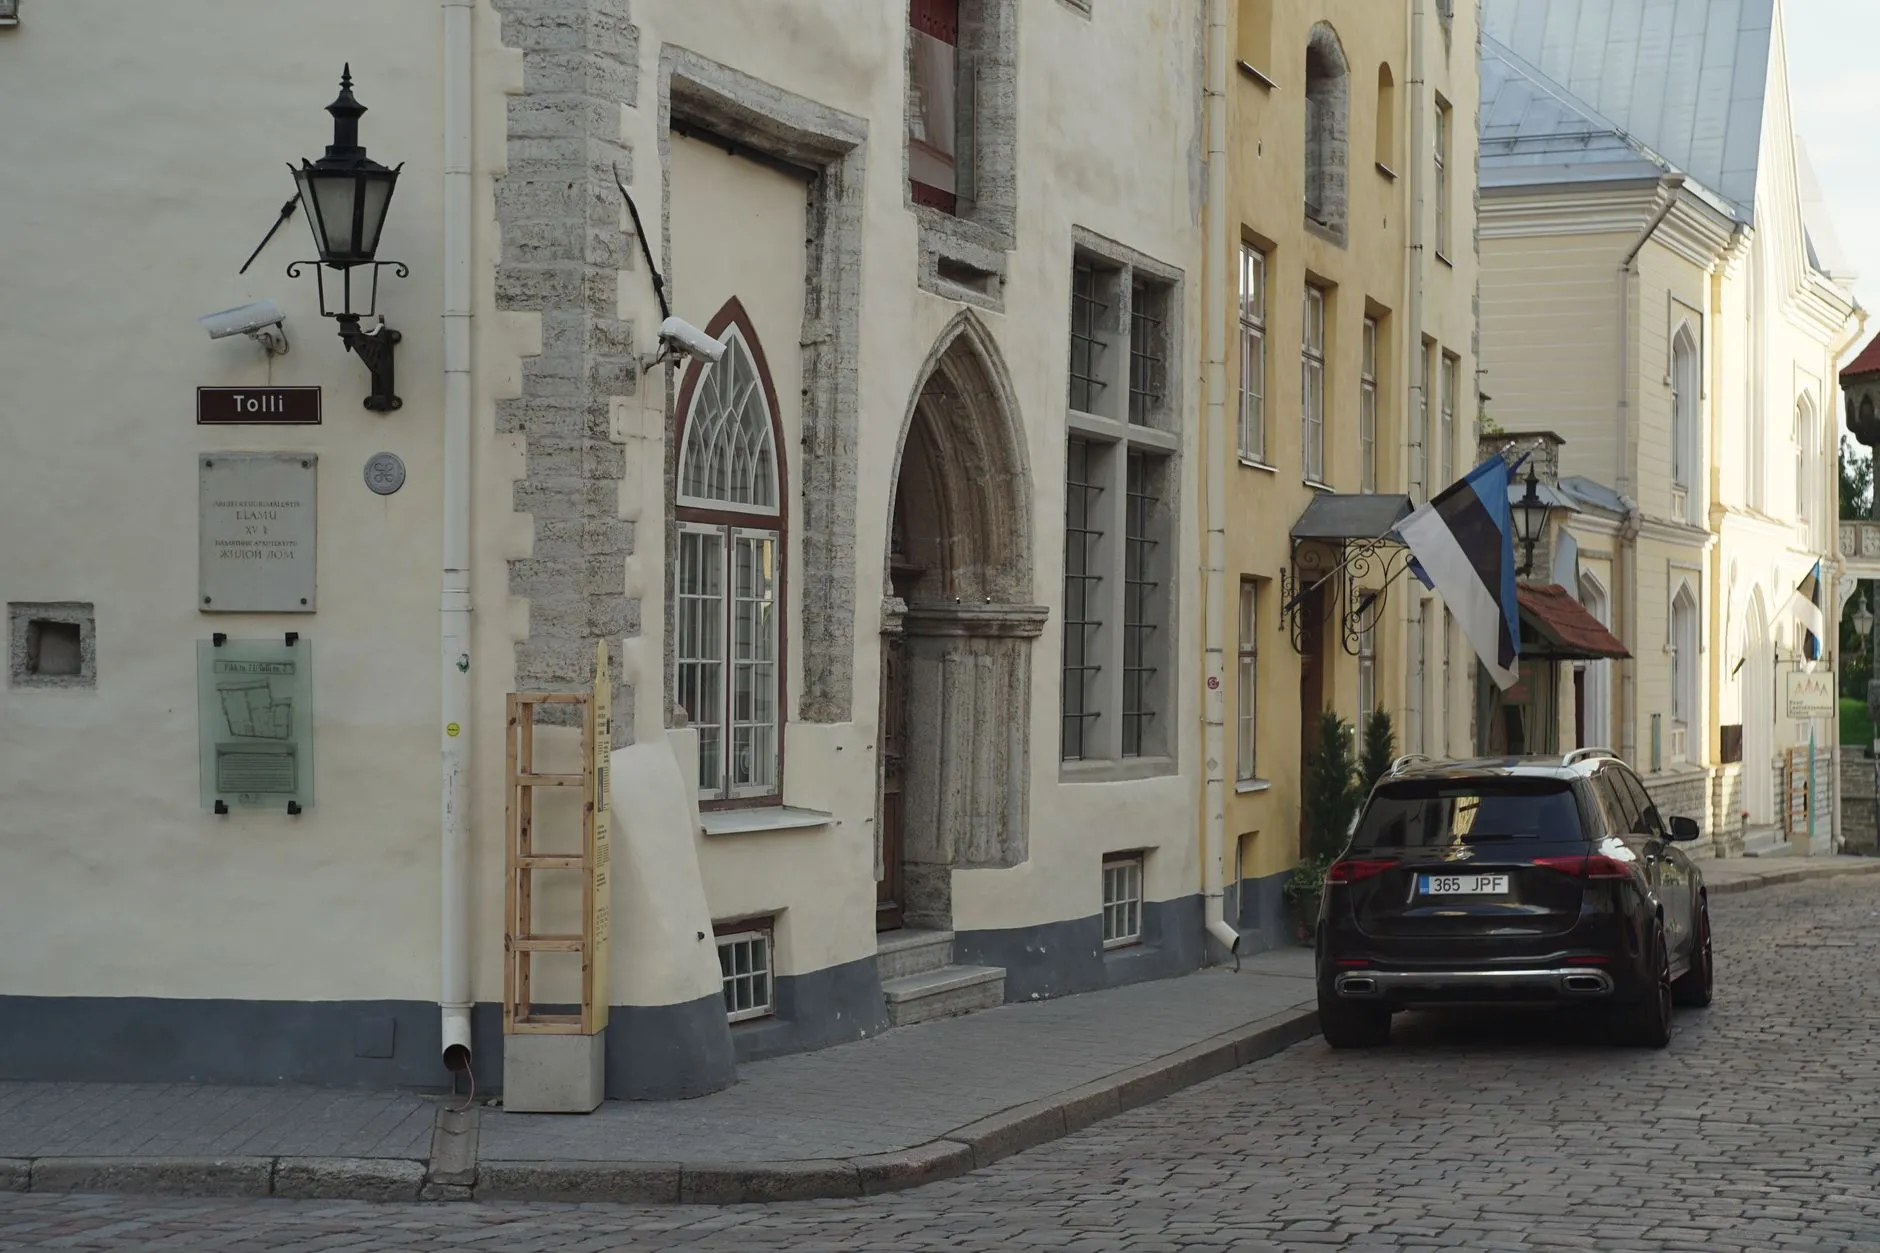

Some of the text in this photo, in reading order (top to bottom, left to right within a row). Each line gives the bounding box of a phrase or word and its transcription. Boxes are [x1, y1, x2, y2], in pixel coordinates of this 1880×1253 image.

[233, 395, 284, 412] Tolli
[236, 510, 277, 520] ELAMU
[1434, 877, 1503, 892] 365 JPF
